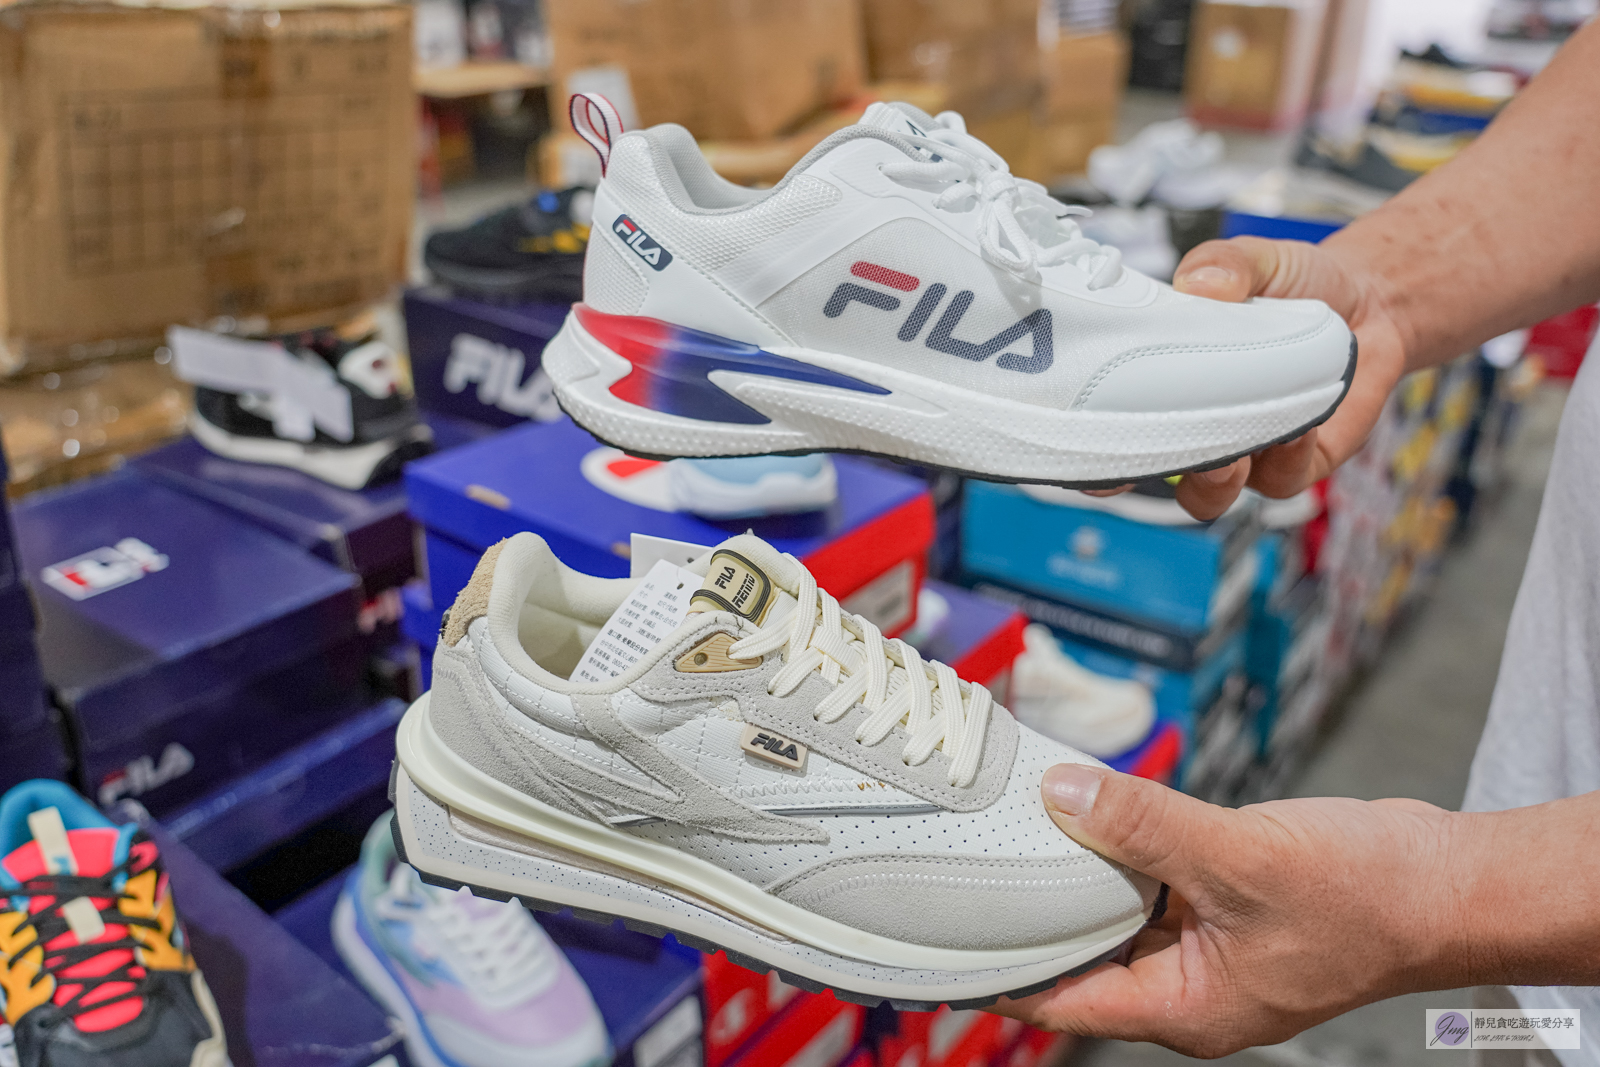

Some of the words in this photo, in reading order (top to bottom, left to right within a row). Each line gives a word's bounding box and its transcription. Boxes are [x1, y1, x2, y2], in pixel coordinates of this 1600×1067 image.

[615, 219, 662, 266] FILA
[822, 261, 1054, 374] FILA
[714, 566, 736, 590] FILA
[750, 732, 799, 762] FILA
